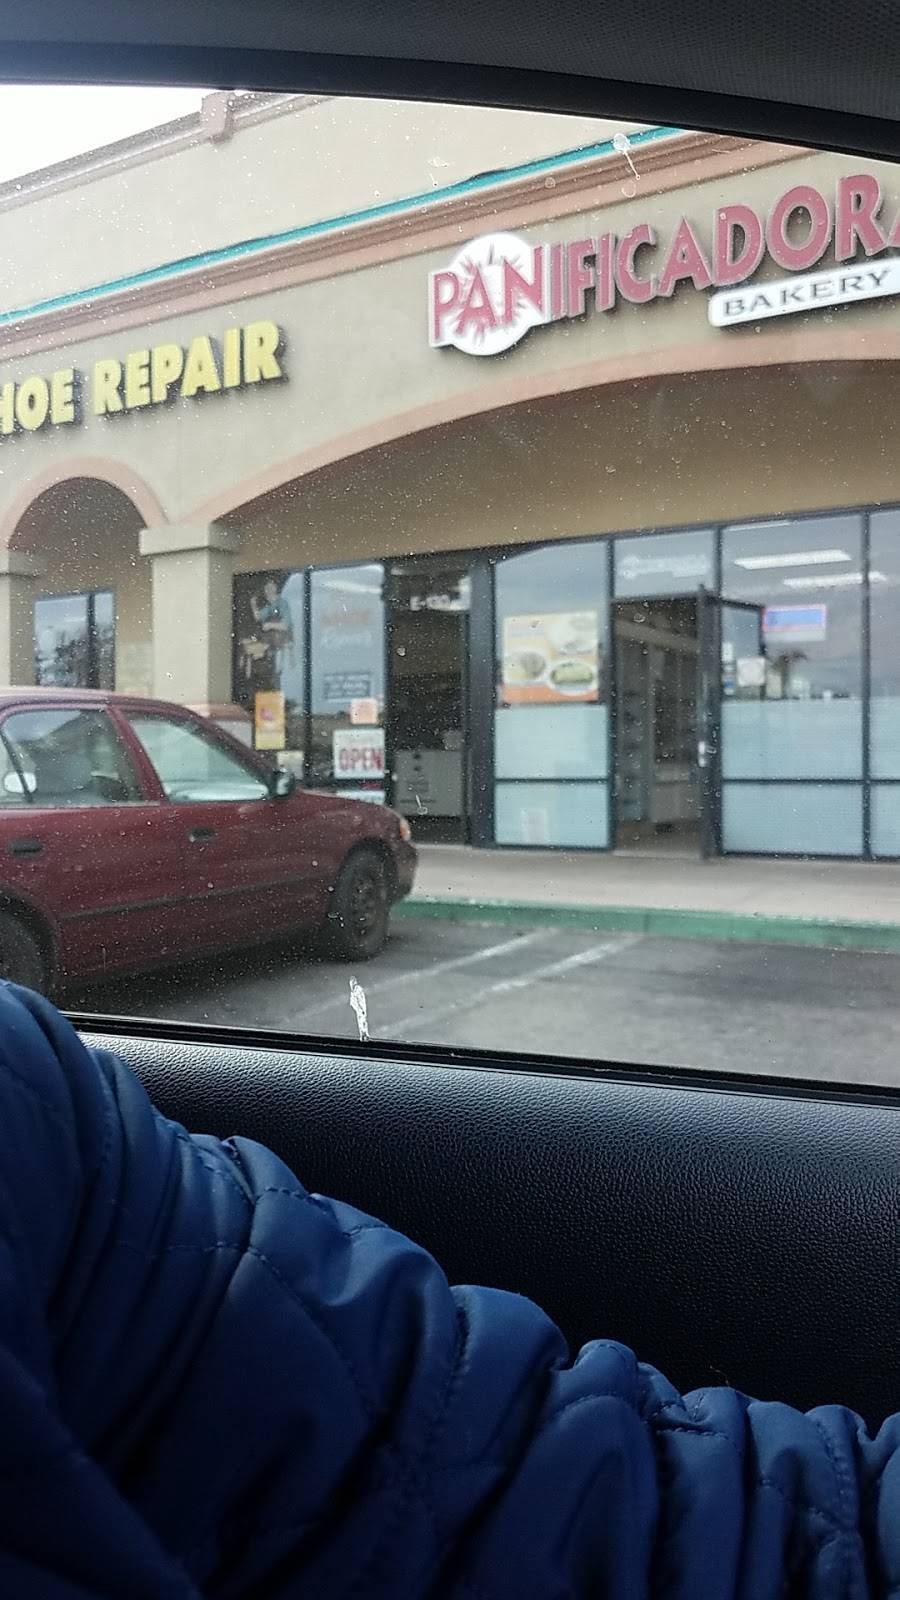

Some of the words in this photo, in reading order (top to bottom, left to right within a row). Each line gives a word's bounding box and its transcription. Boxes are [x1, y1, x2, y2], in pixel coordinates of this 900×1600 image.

[430, 173, 900, 341] PANIFICADOR
[723, 268, 890, 316] BAKERY
[95, 320, 282, 415] REPAIR
[339, 747, 384, 771] OPEN
